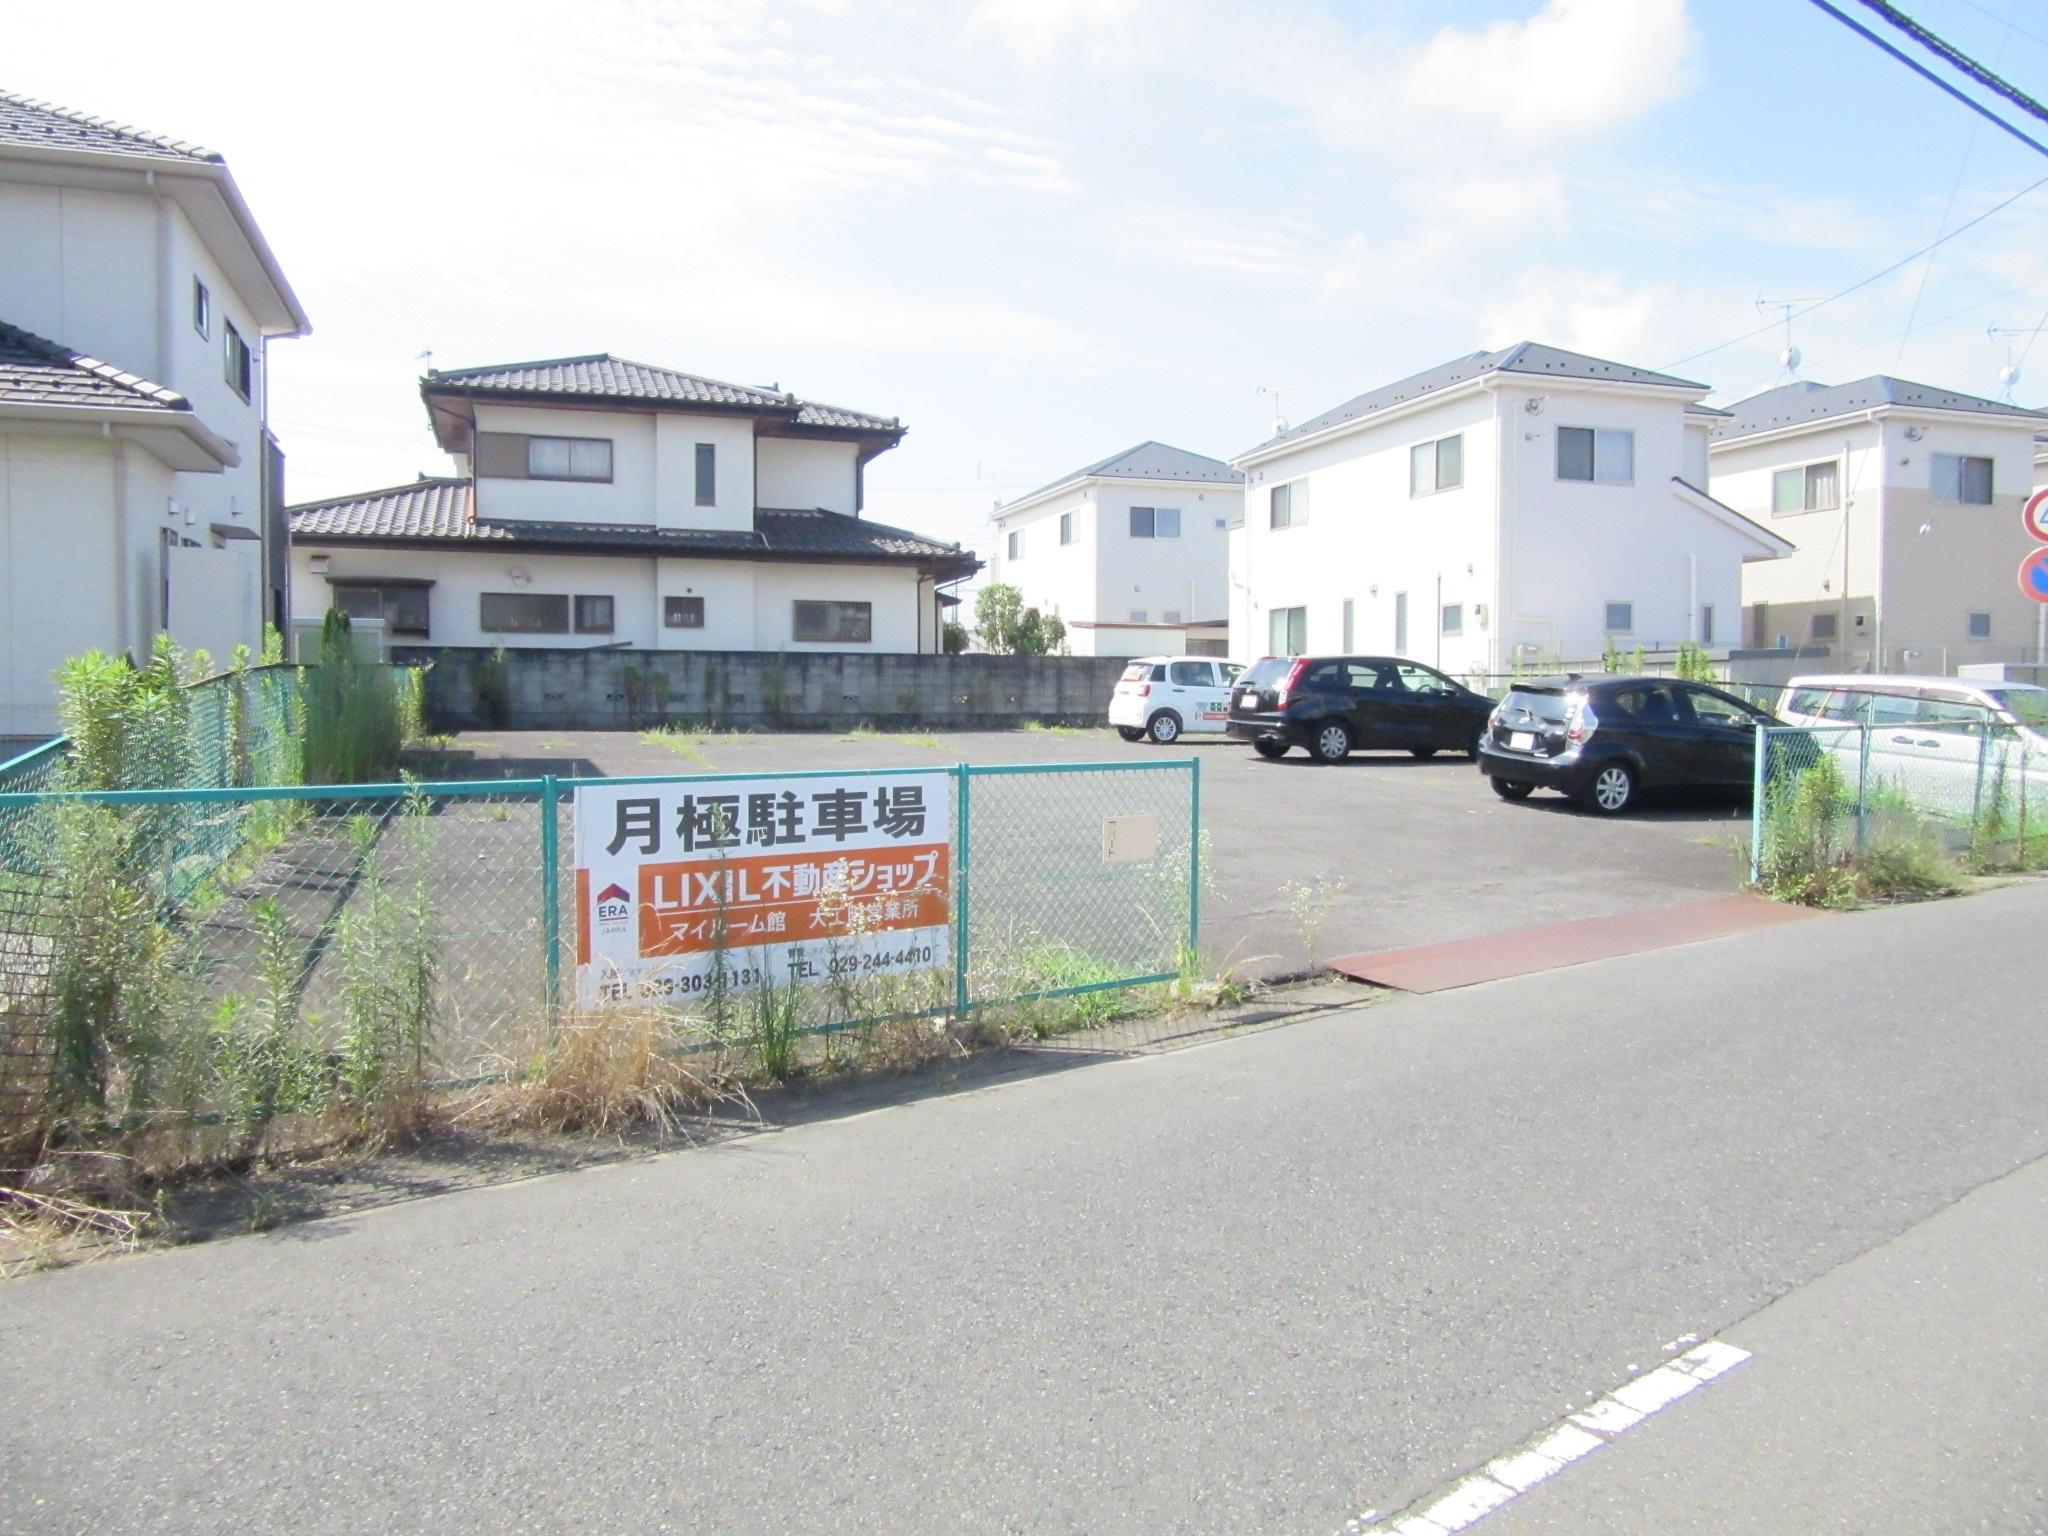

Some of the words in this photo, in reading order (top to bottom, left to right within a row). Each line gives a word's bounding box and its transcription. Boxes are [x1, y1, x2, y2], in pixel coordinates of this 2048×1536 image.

[606, 785, 926, 857] 月極駐車場
[655, 851, 938, 909] LIXIL不動産ショップ
[599, 905, 628, 917] ERA
[670, 911, 786, 941] マイルーム館
[640, 967, 760, 998] 29-3031131
[787, 961, 820, 977] TEL
